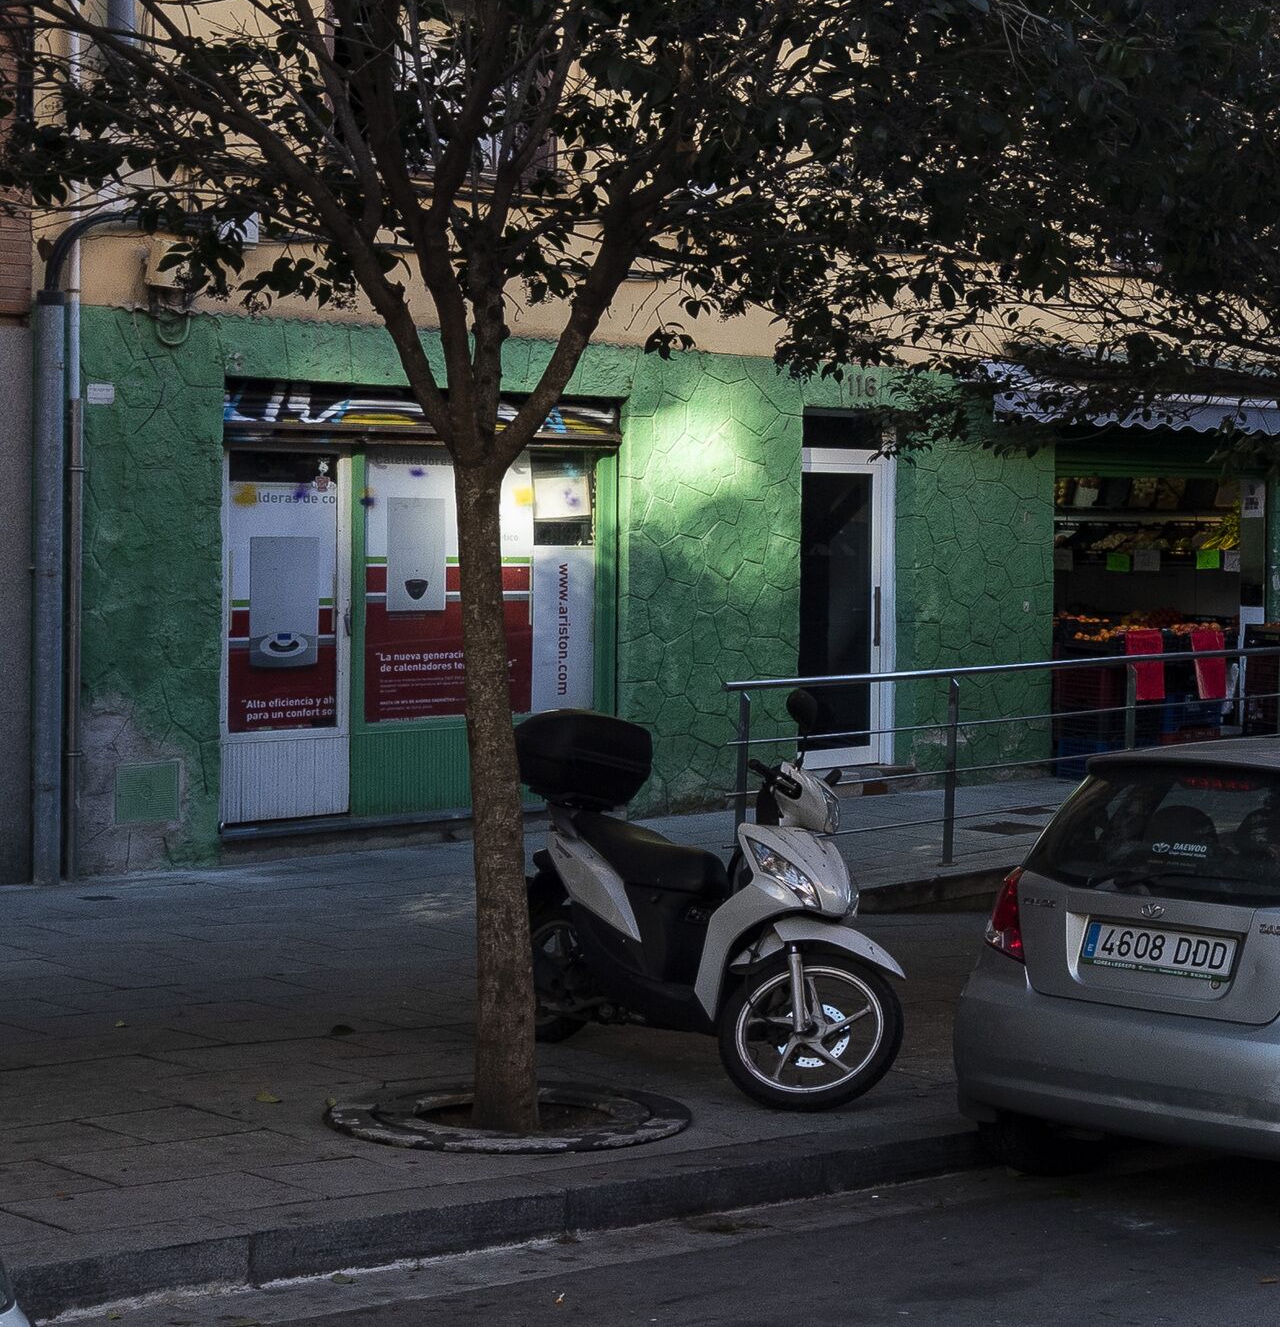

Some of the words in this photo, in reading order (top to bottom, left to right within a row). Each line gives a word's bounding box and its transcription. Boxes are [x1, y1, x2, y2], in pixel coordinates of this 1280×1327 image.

[847, 374, 878, 397] 116
[246, 492, 299, 504] alderas
[303, 492, 318, 504] de
[558, 563, 571, 695] www.ariston.com
[394, 653, 421, 661] nueva
[380, 663, 392, 672] de
[394, 662, 452, 672] calentadores
[268, 697, 314, 708] eficiencia
[315, 697, 321, 706] y
[246, 712, 269, 722] para
[271, 711, 284, 719] un
[286, 708, 320, 718] confort
[1173, 842, 1207, 853] DAEWOO
[1101, 928, 1166, 961] 4608
[1173, 937, 1228, 969] DDD
